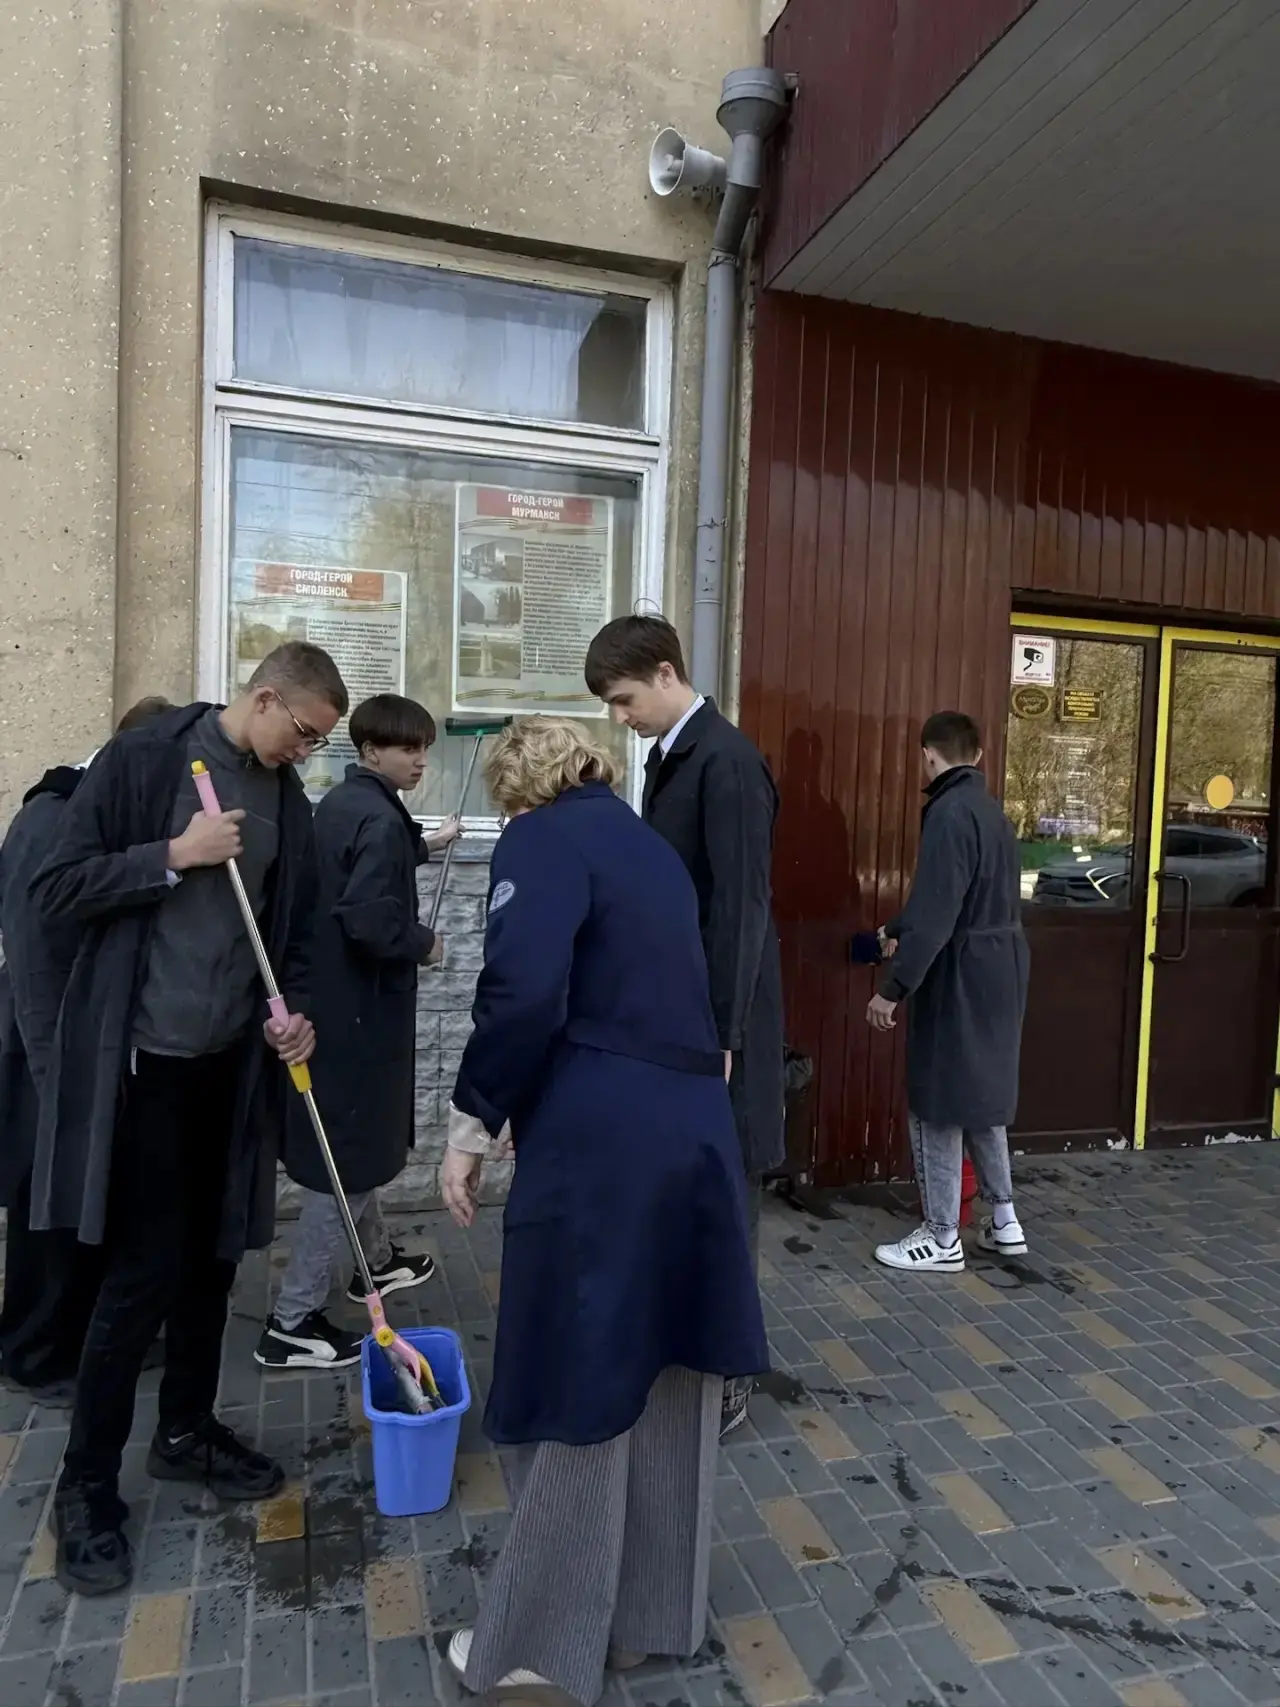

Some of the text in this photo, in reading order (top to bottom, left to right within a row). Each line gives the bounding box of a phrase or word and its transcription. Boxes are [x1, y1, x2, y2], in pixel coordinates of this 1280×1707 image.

[511, 506, 560, 521] МУРМАНСК
[290, 569, 353, 583] ГОРОД-ГЕРОЙ
[295, 584, 348, 597] СМОЛЕНСК
